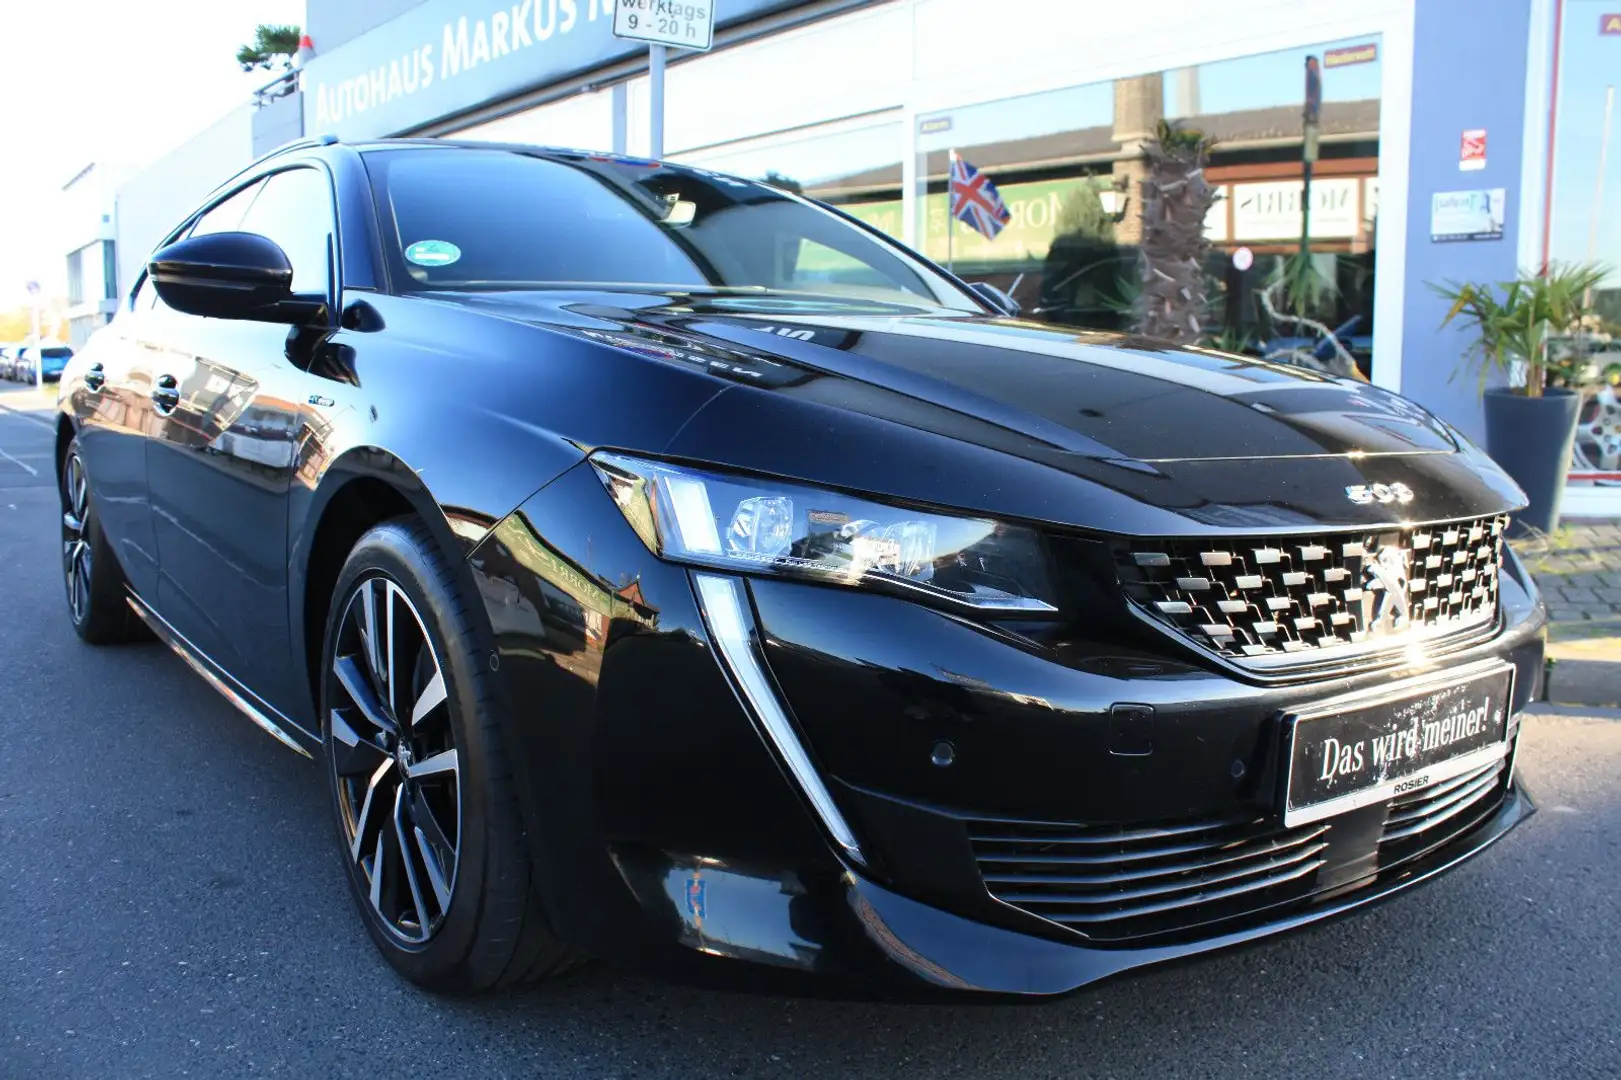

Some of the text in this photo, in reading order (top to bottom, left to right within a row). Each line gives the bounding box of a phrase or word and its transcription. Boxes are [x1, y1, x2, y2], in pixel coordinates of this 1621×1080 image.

[622, 0, 706, 21] werktags
[628, 14, 638, 29] 9
[658, 18, 679, 35] 20
[685, 23, 696, 38] h
[315, 0, 577, 131] AUTOHAUS MARKUS
[1320, 697, 1489, 780] Das wird meiner!
[1394, 775, 1430, 795] ROSIER
